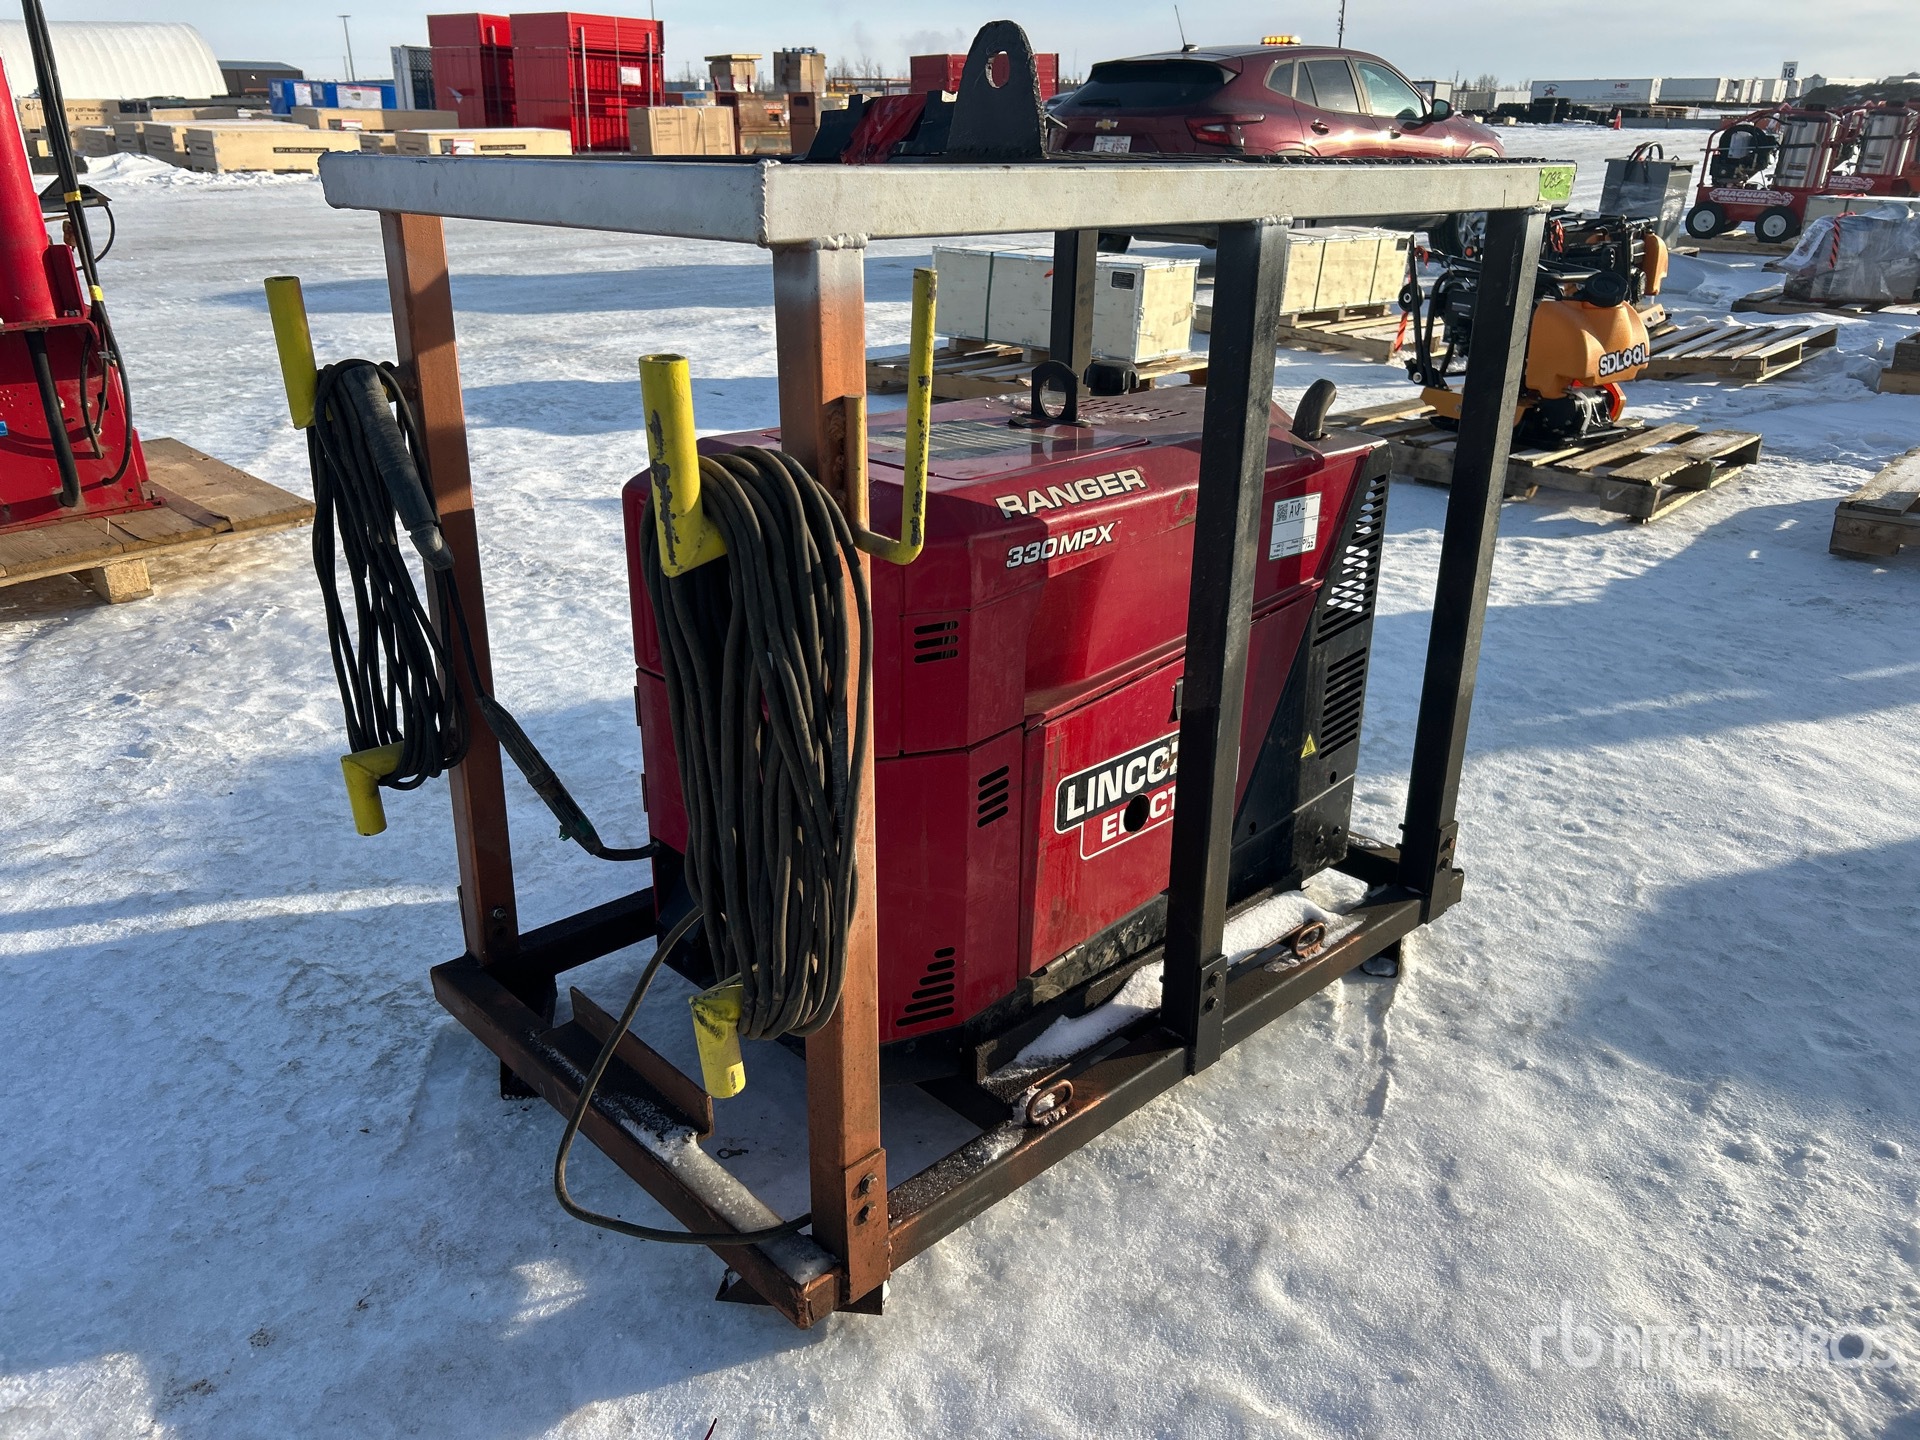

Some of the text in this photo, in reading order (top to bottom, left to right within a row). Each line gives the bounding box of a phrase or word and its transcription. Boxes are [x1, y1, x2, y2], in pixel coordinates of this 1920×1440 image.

[1783, 67, 1795, 78] 18
[1717, 190, 1768, 199] MAGNUM
[995, 468, 1147, 519] RANGER
[1006, 522, 1116, 569] 330MPX
